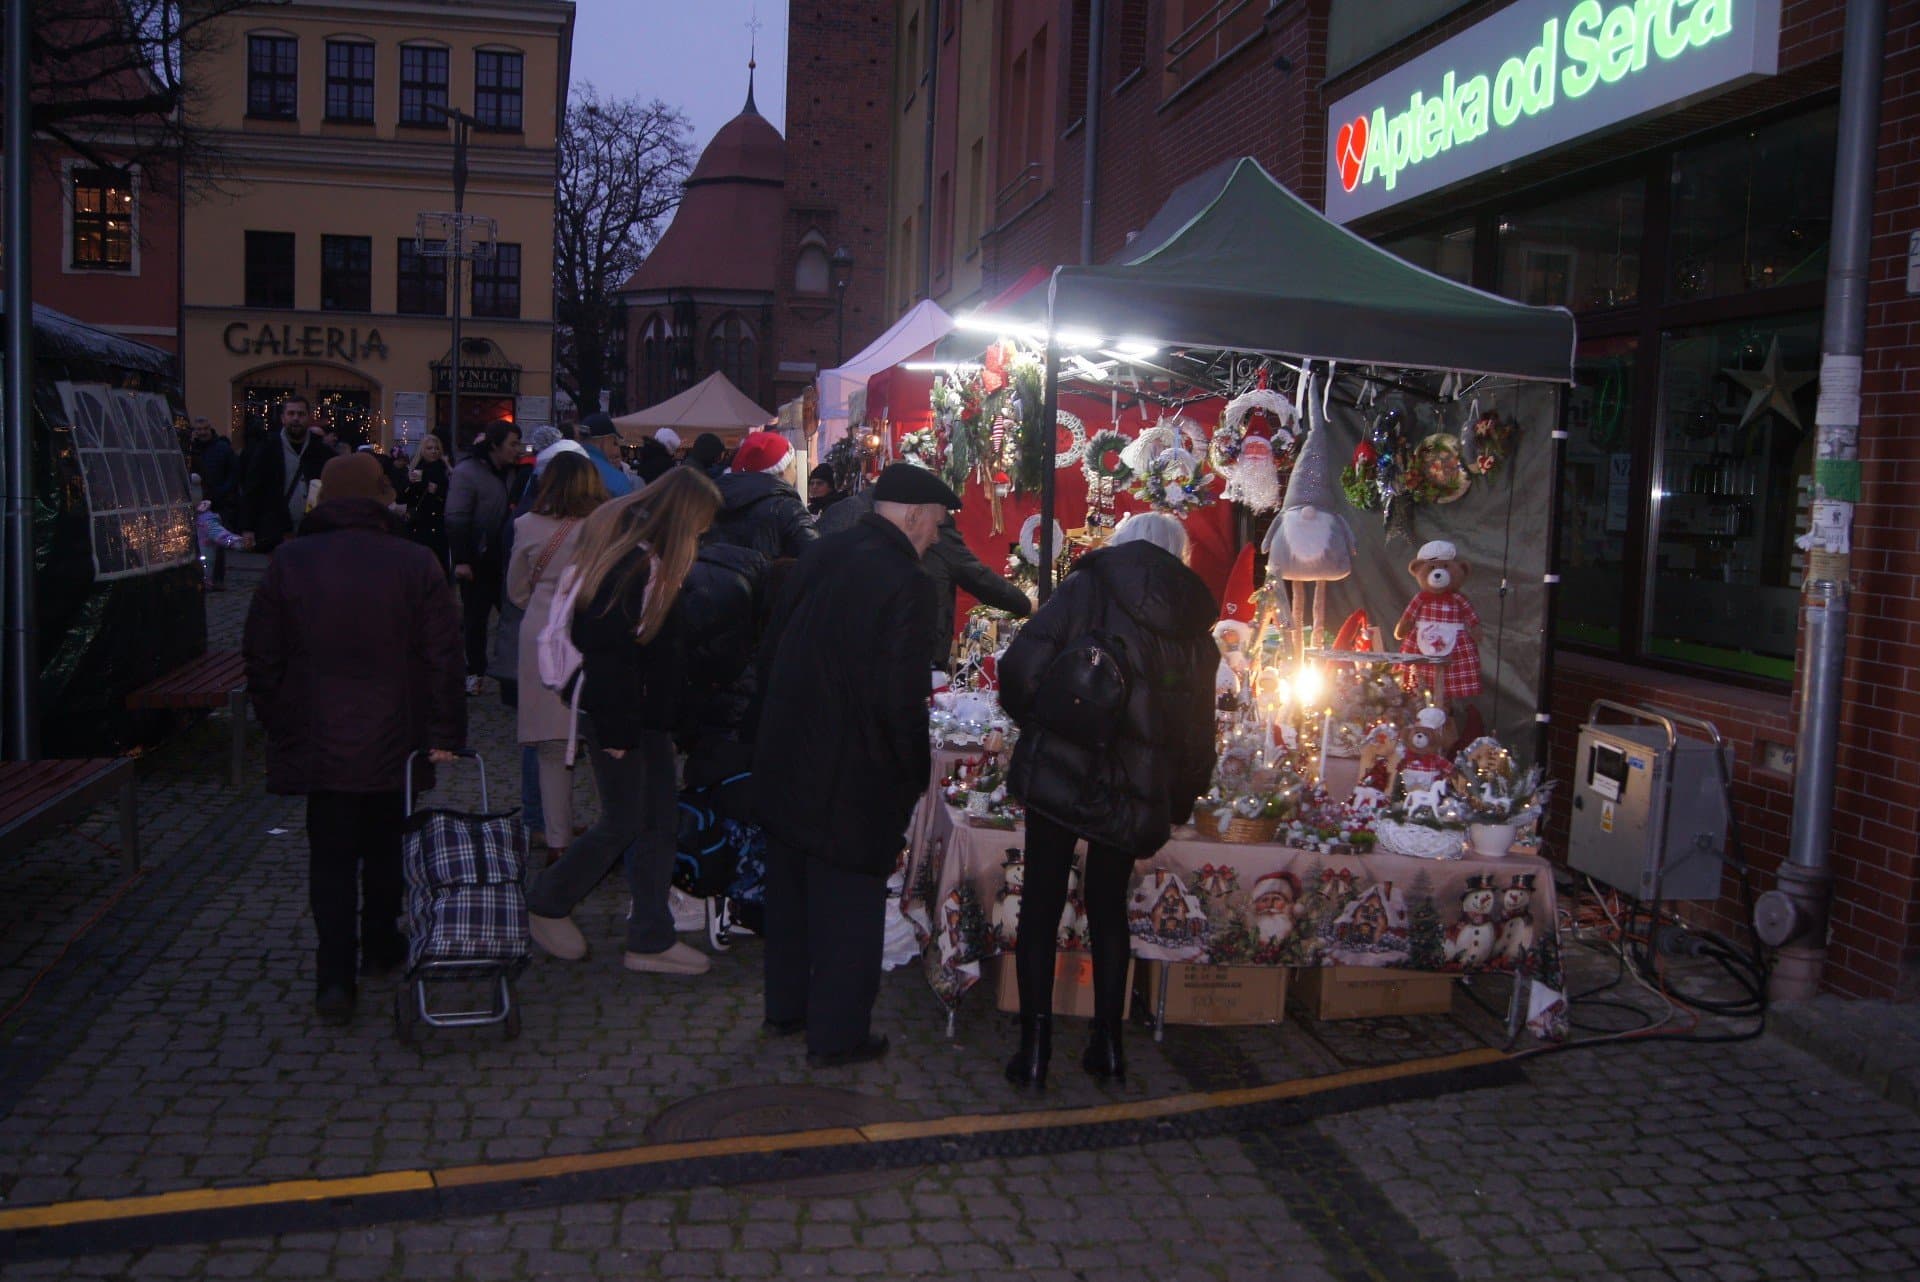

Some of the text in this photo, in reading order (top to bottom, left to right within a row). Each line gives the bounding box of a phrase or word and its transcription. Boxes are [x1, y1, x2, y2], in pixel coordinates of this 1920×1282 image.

[1362, 0, 1732, 191] Apteka od Serca
[223, 322, 388, 361] GALERIA
